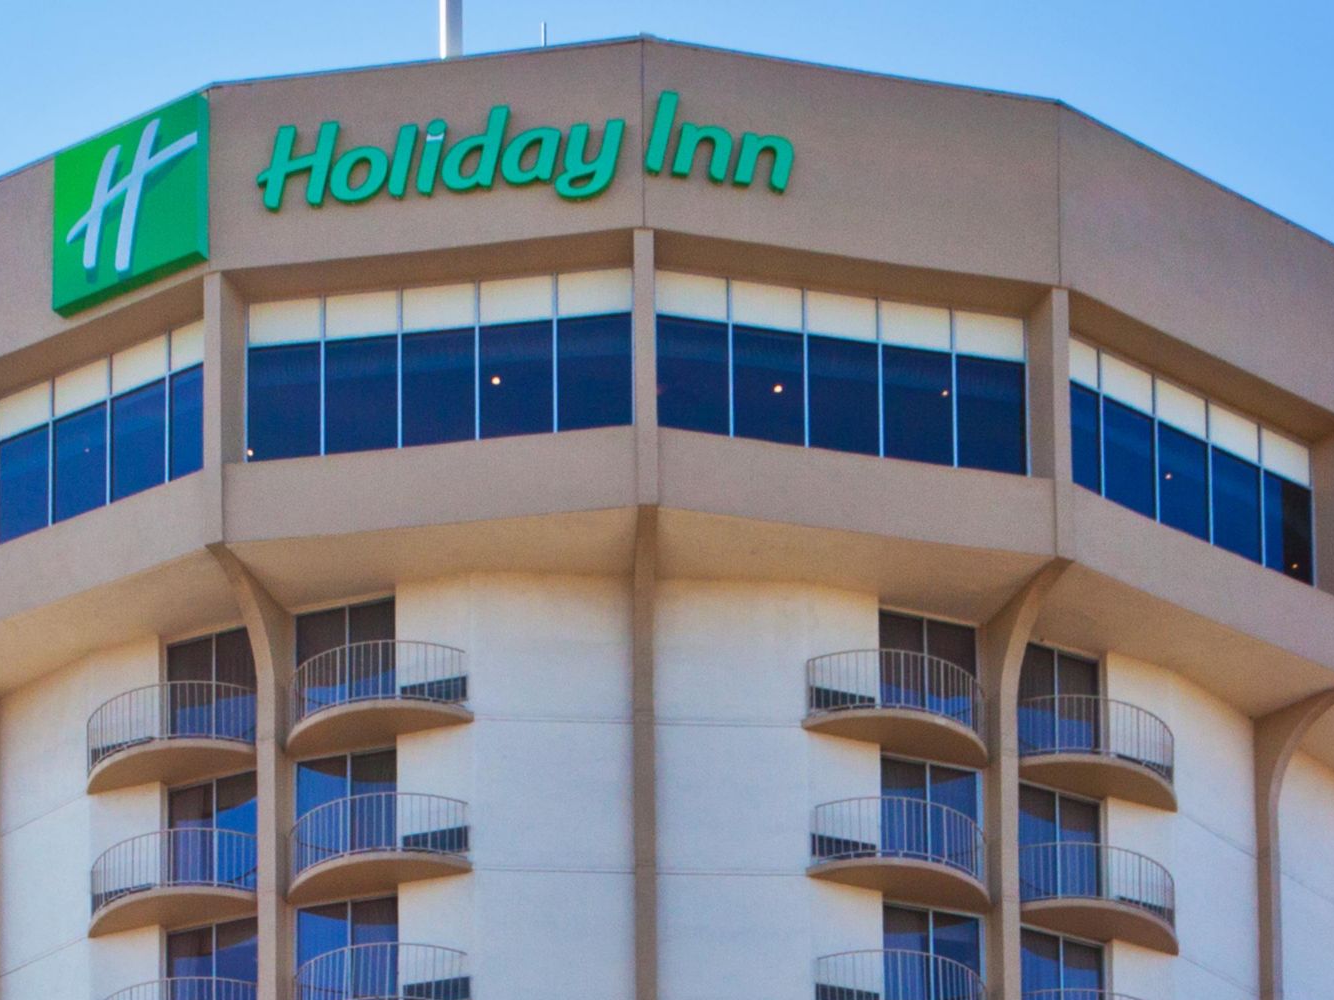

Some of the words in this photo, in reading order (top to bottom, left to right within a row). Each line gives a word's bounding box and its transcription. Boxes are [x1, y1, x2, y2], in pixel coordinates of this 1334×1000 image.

[66, 117, 199, 273] H
[257, 105, 626, 212] Holiday
[644, 91, 795, 193] Inn
